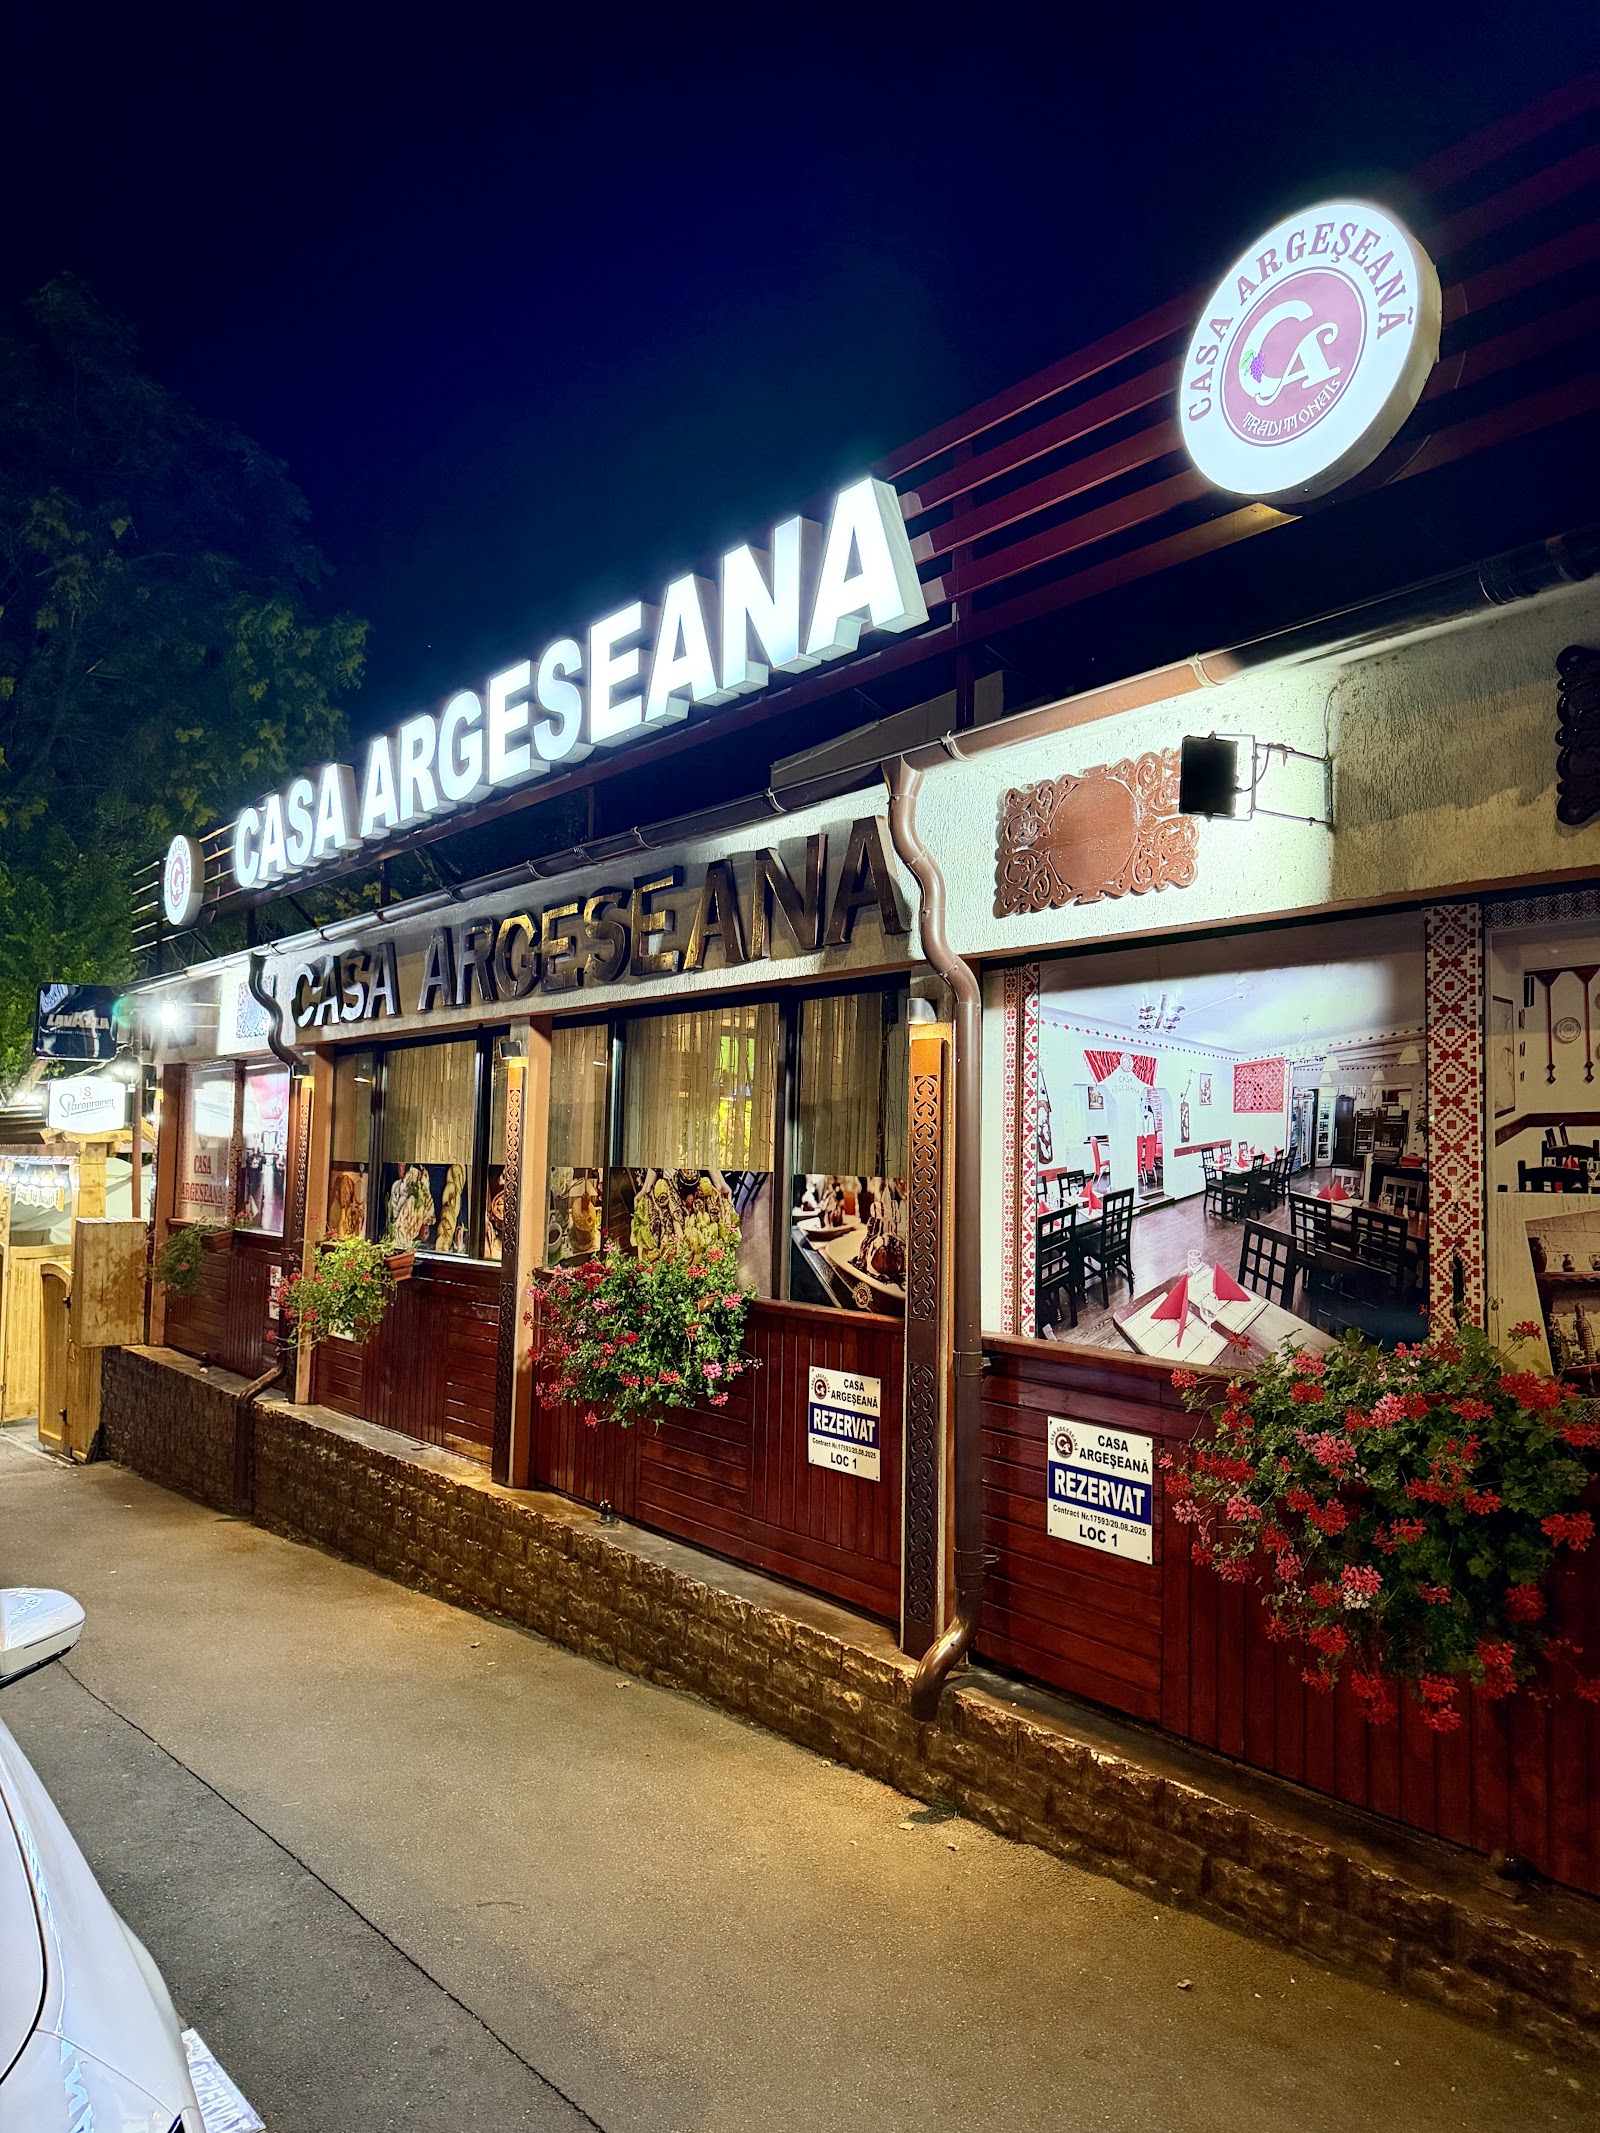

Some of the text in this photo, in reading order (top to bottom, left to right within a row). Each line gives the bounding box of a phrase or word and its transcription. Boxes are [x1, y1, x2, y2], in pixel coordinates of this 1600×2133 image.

[1189, 313, 1233, 422] CASA
[233, 476, 922, 889] CASA ARGESEANA
[291, 814, 911, 1028] CASA ARGESEANA
[193, 1155, 212, 1175] CASA
[843, 1379, 865, 1392] CASA
[813, 1408, 876, 1443] REZERVAT
[1097, 1434, 1129, 1453] CASA
[830, 1452, 857, 1469] LOC 1
[1054, 1468, 1146, 1516] REZERVAT
[1052, 1504, 1080, 1519] Contract
[1079, 1524, 1118, 1548] LOC 1
